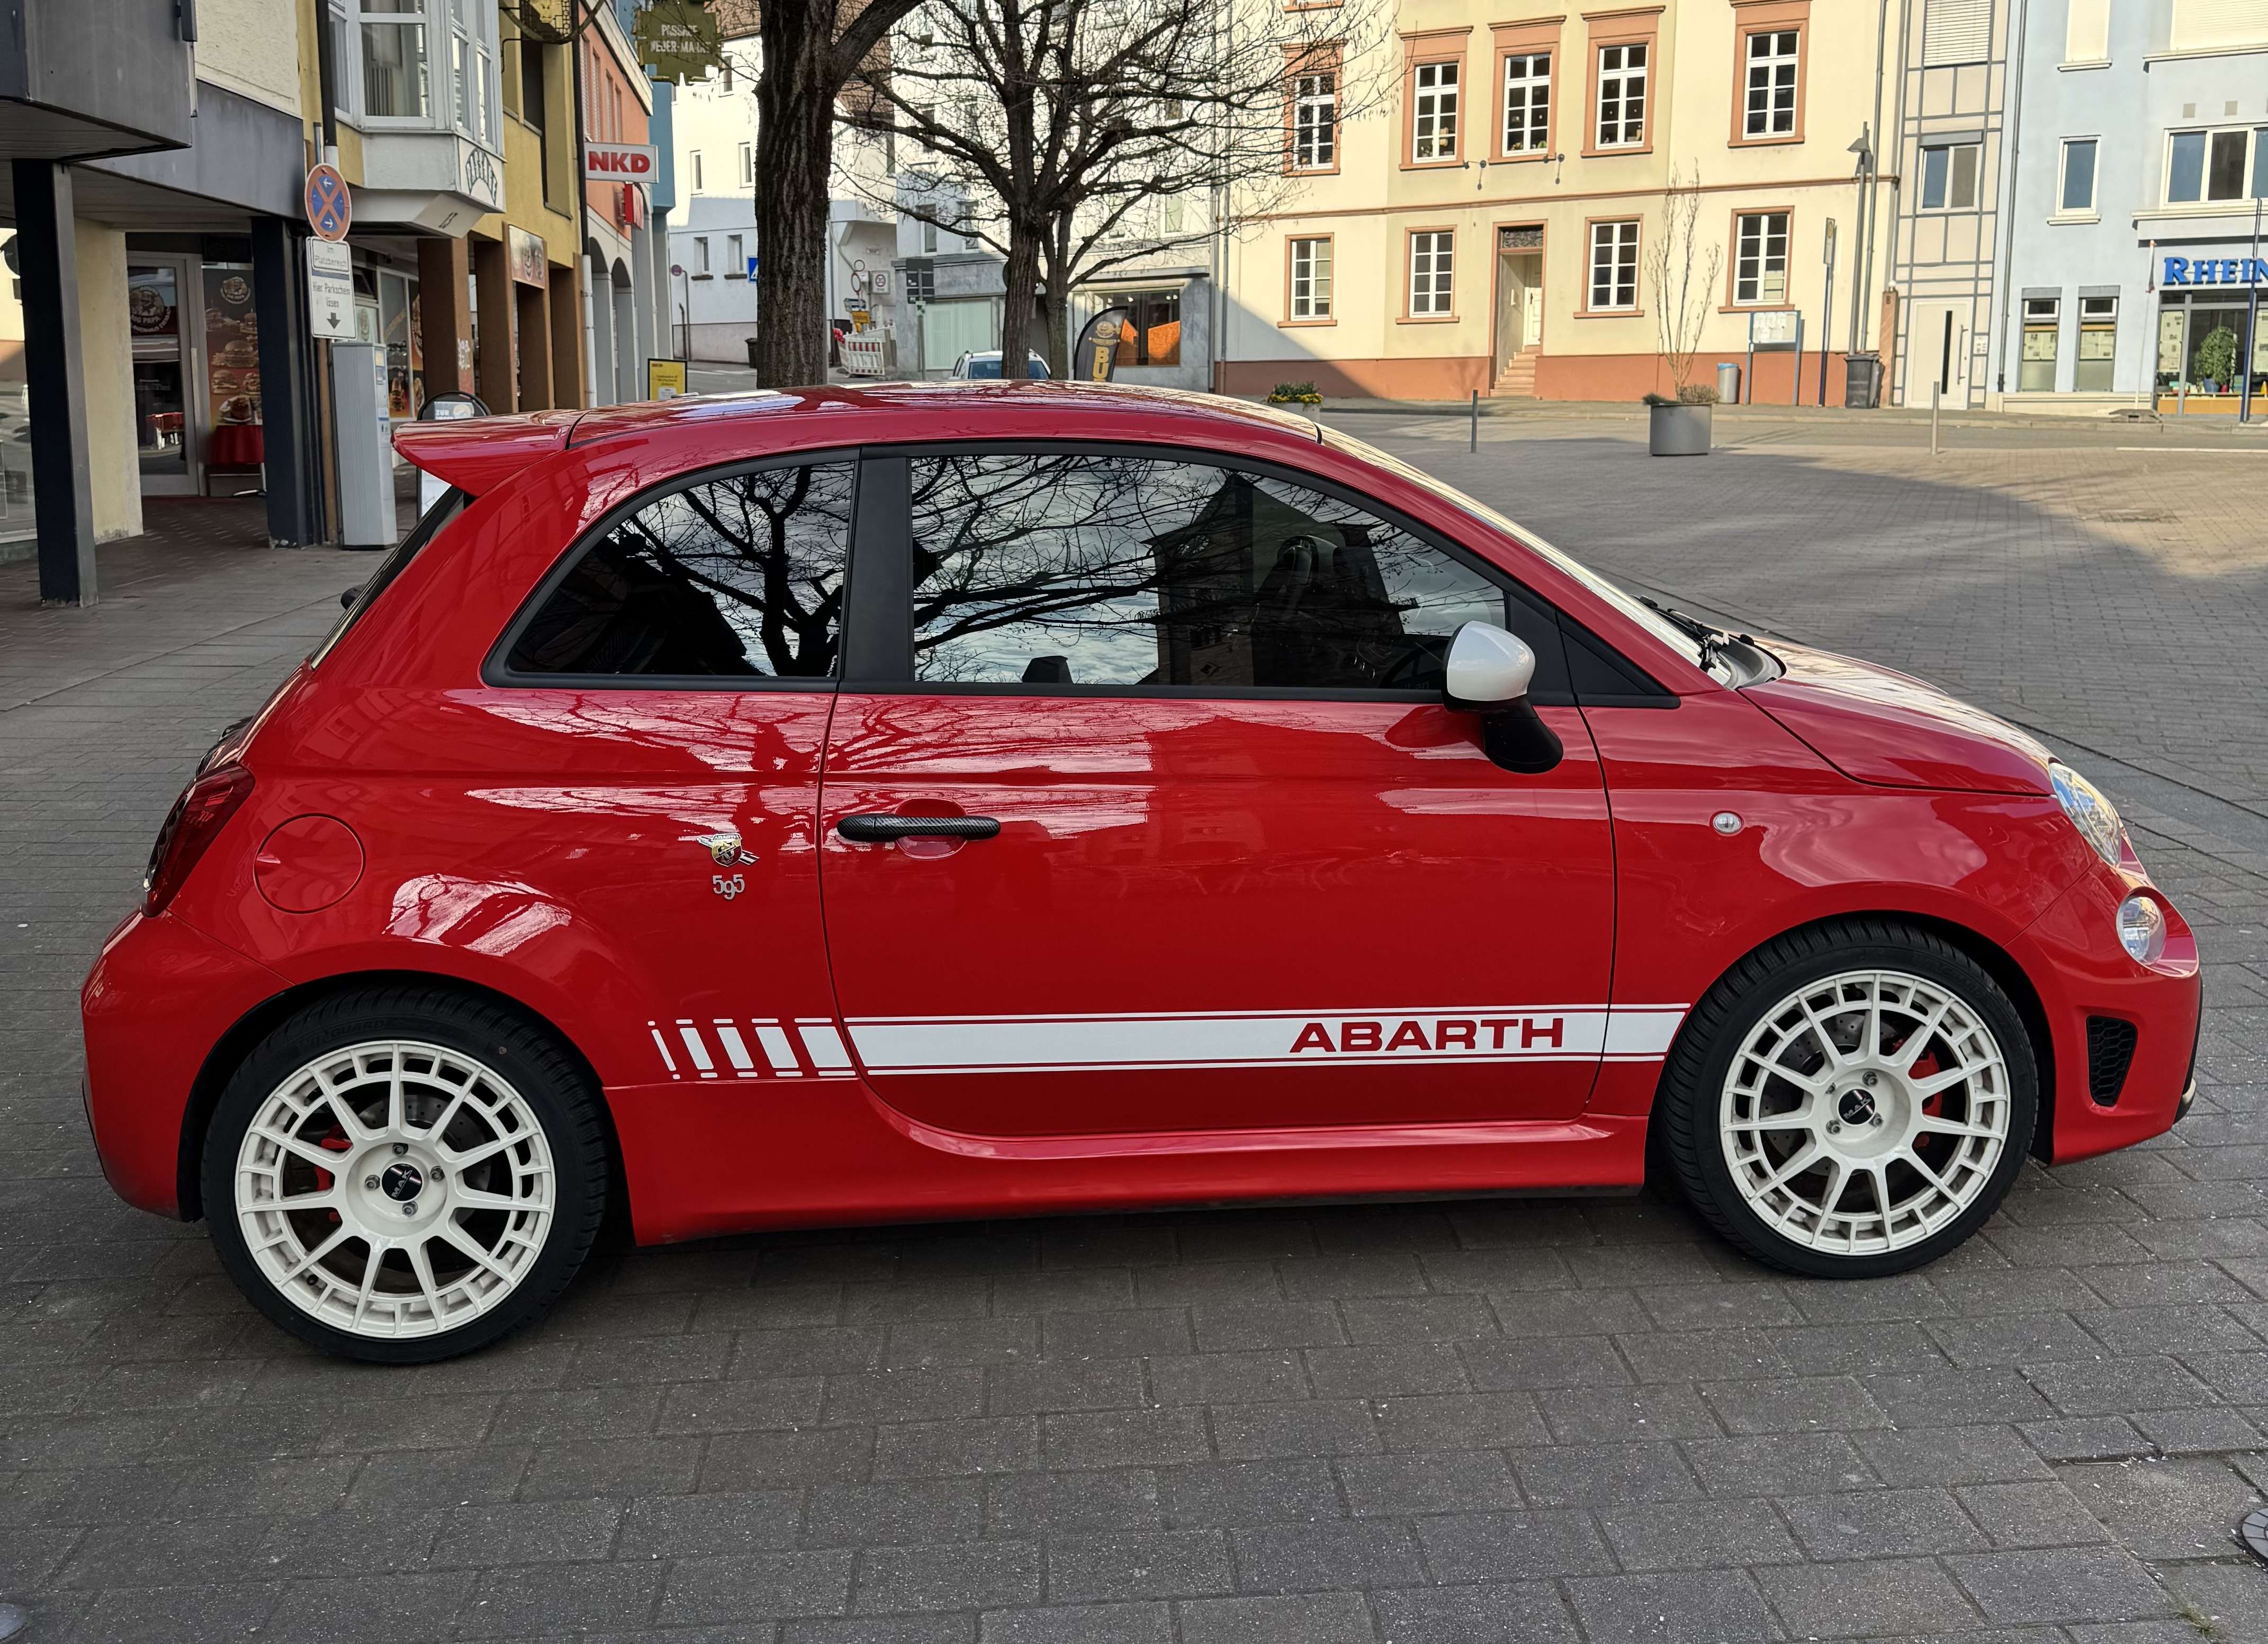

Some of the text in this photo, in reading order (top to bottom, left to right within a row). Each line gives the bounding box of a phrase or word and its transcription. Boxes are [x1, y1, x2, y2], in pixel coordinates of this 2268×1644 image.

[589, 151, 650, 173] NKD
[1093, 346, 1110, 381] BU
[712, 874, 745, 900] 595
[1289, 1018, 1564, 1054] ABARTH
[1843, 1097, 1871, 1120] MAK
[390, 1169, 412, 1198] MAK
